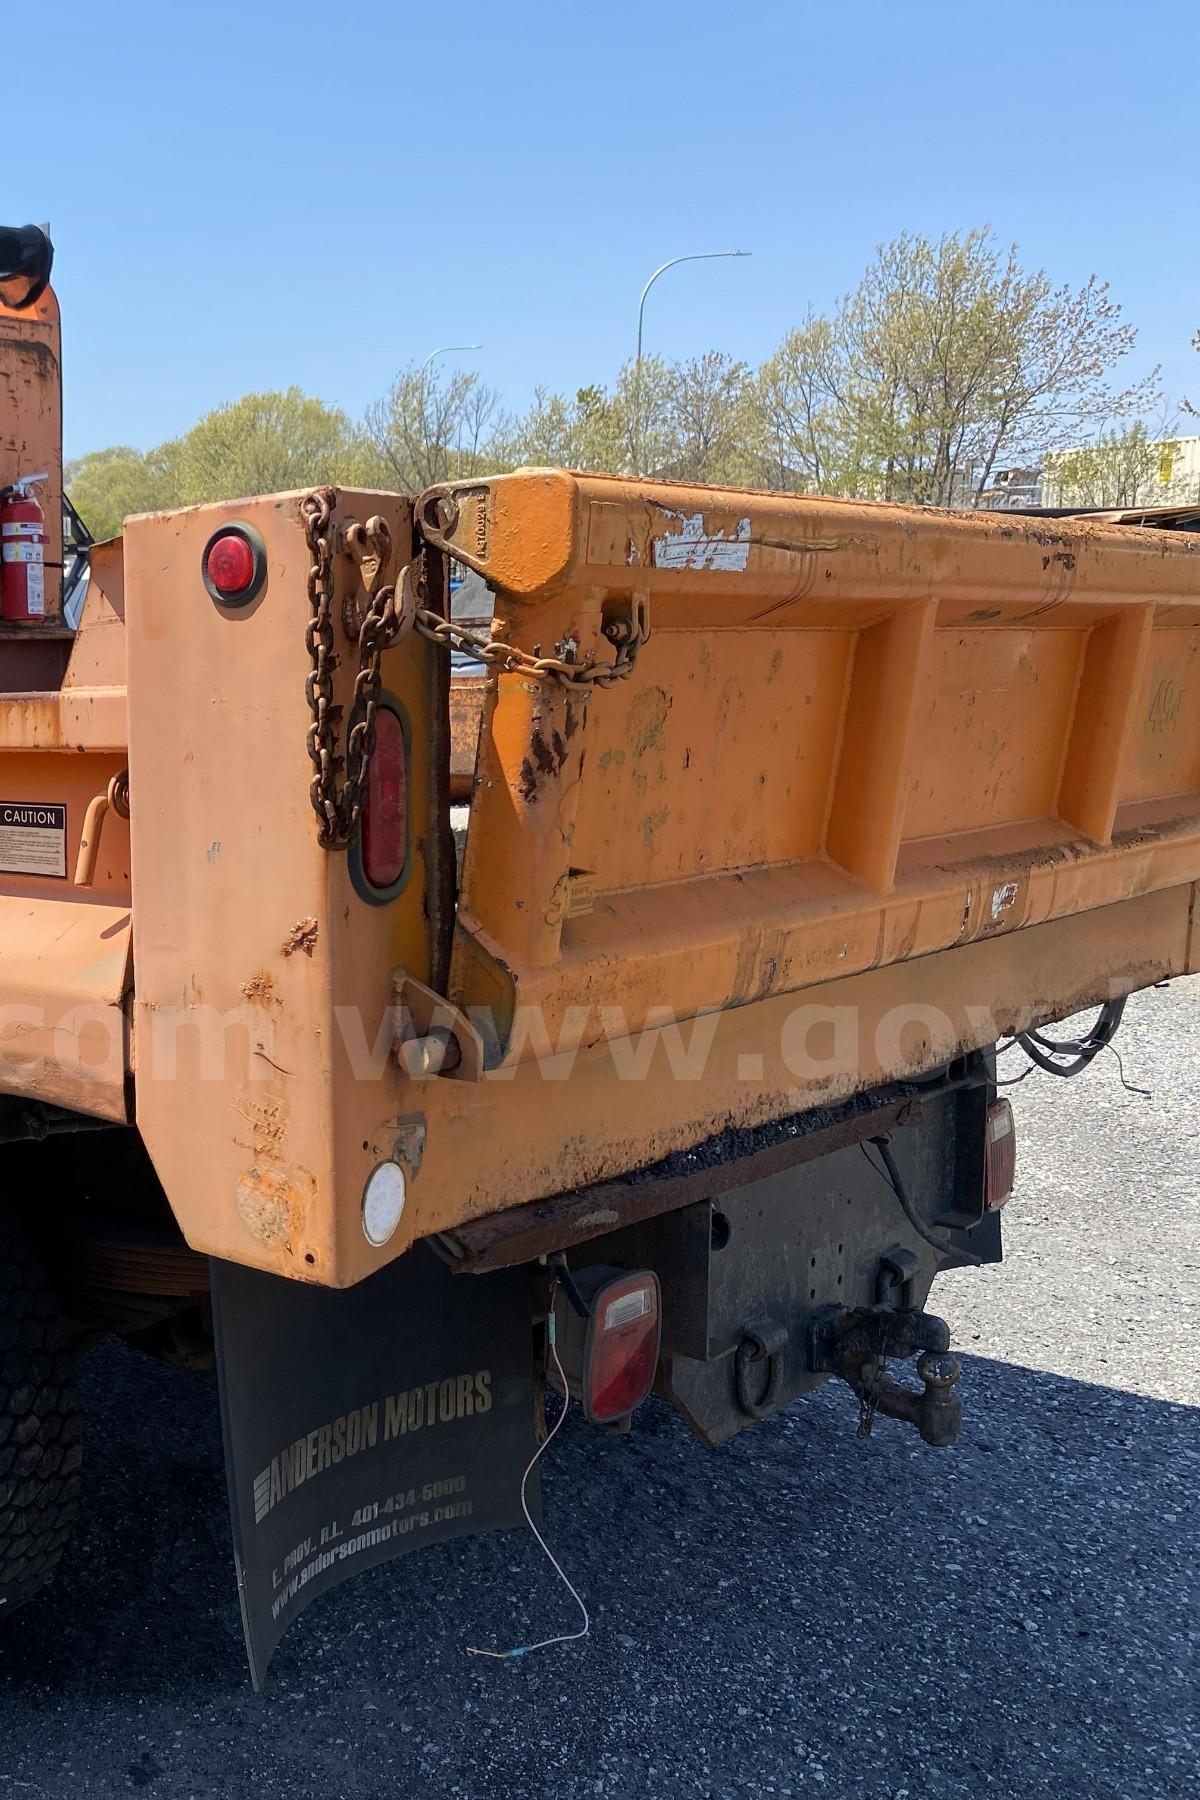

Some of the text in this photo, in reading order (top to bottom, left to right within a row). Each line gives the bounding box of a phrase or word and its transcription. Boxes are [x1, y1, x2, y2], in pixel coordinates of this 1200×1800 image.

[4, 809, 55, 825] CAUTION
[270, 1369, 493, 1509] ANDERSON MOTORS
